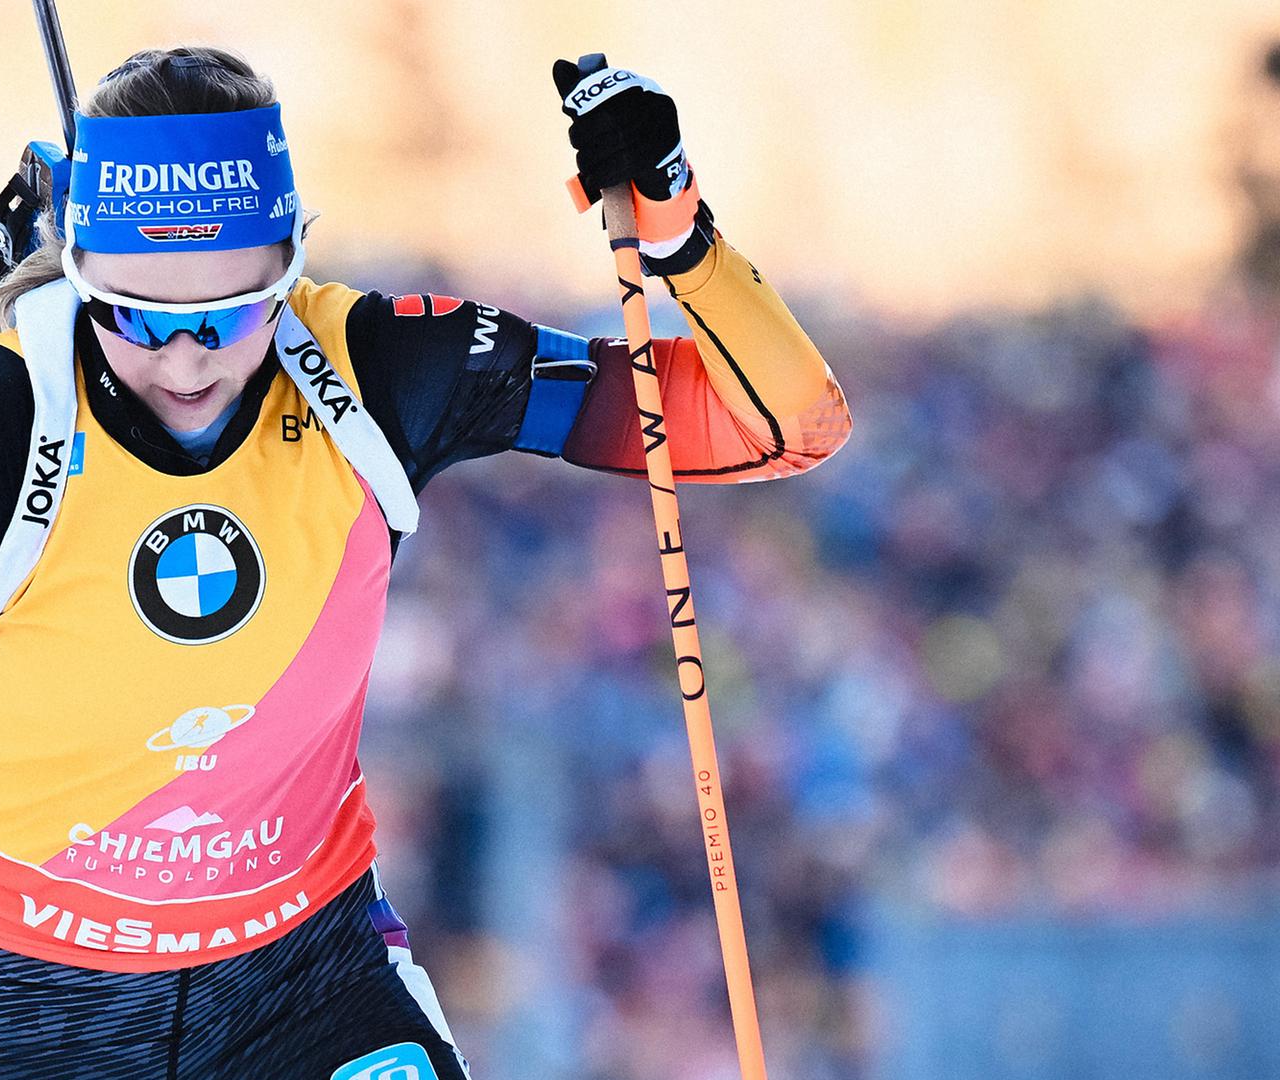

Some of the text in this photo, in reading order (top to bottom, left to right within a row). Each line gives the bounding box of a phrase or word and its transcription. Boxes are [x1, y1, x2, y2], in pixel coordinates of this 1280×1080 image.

[97, 158, 261, 197] ERDINGER
[96, 195, 260, 216] ALKOHOLFREI
[177, 222, 223, 241] DSV
[283, 340, 357, 424] JOKA
[281, 405, 321, 442] BM
[21, 434, 66, 529] JOKA
[145, 511, 240, 555] BMW
[174, 753, 219, 771] IBU
[68, 815, 285, 864] CHIEMGAU
[697, 769, 728, 892] PREMIO 40
[66, 848, 283, 884] RUHPOLDING
